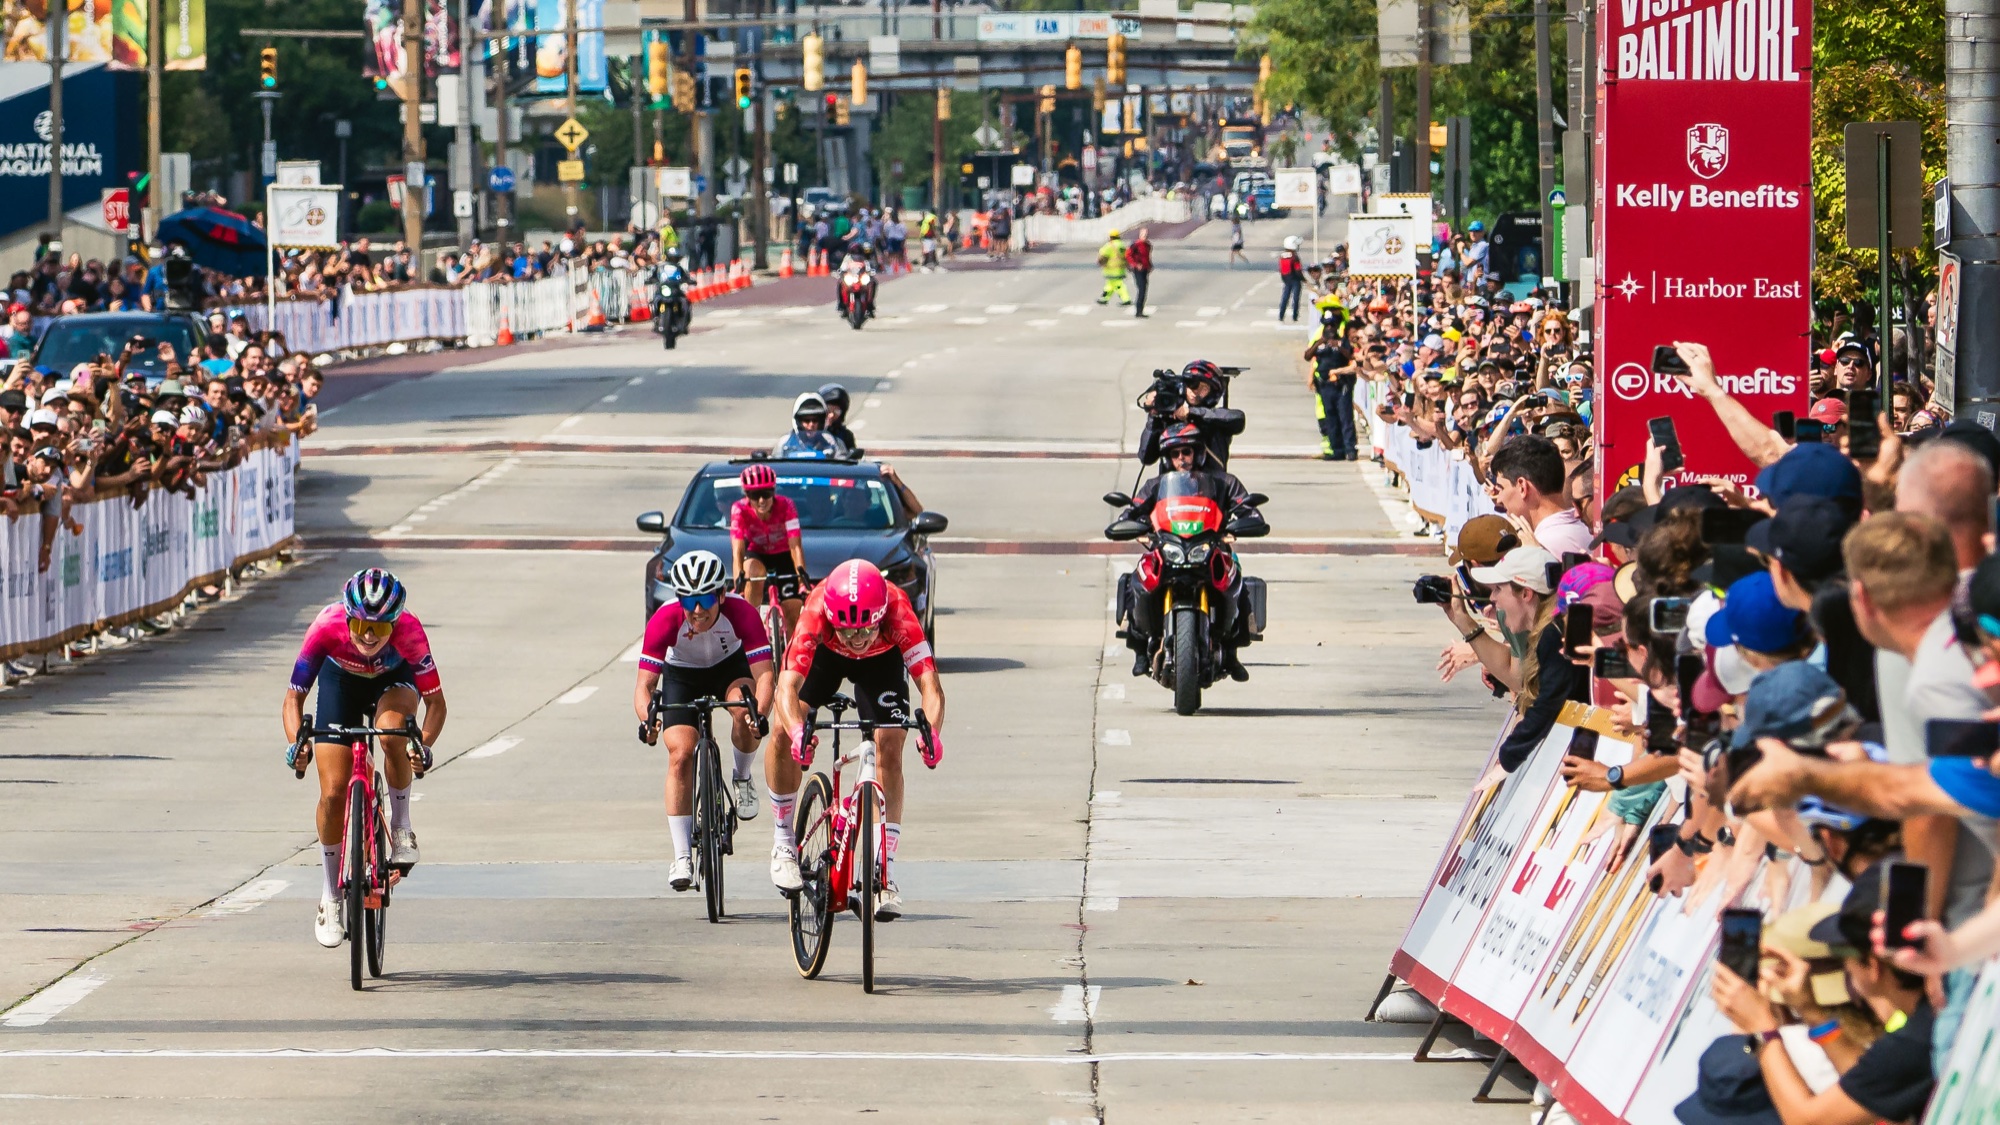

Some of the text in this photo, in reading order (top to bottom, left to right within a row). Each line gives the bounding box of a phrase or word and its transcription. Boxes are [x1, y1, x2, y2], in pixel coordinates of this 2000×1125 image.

[1618, 0, 1800, 81] BALTIMORE
[1616, 184, 1800, 212] Kelly Benefits
[1664, 277, 1802, 299] Harbor East
[1177, 522, 1190, 531] TV
